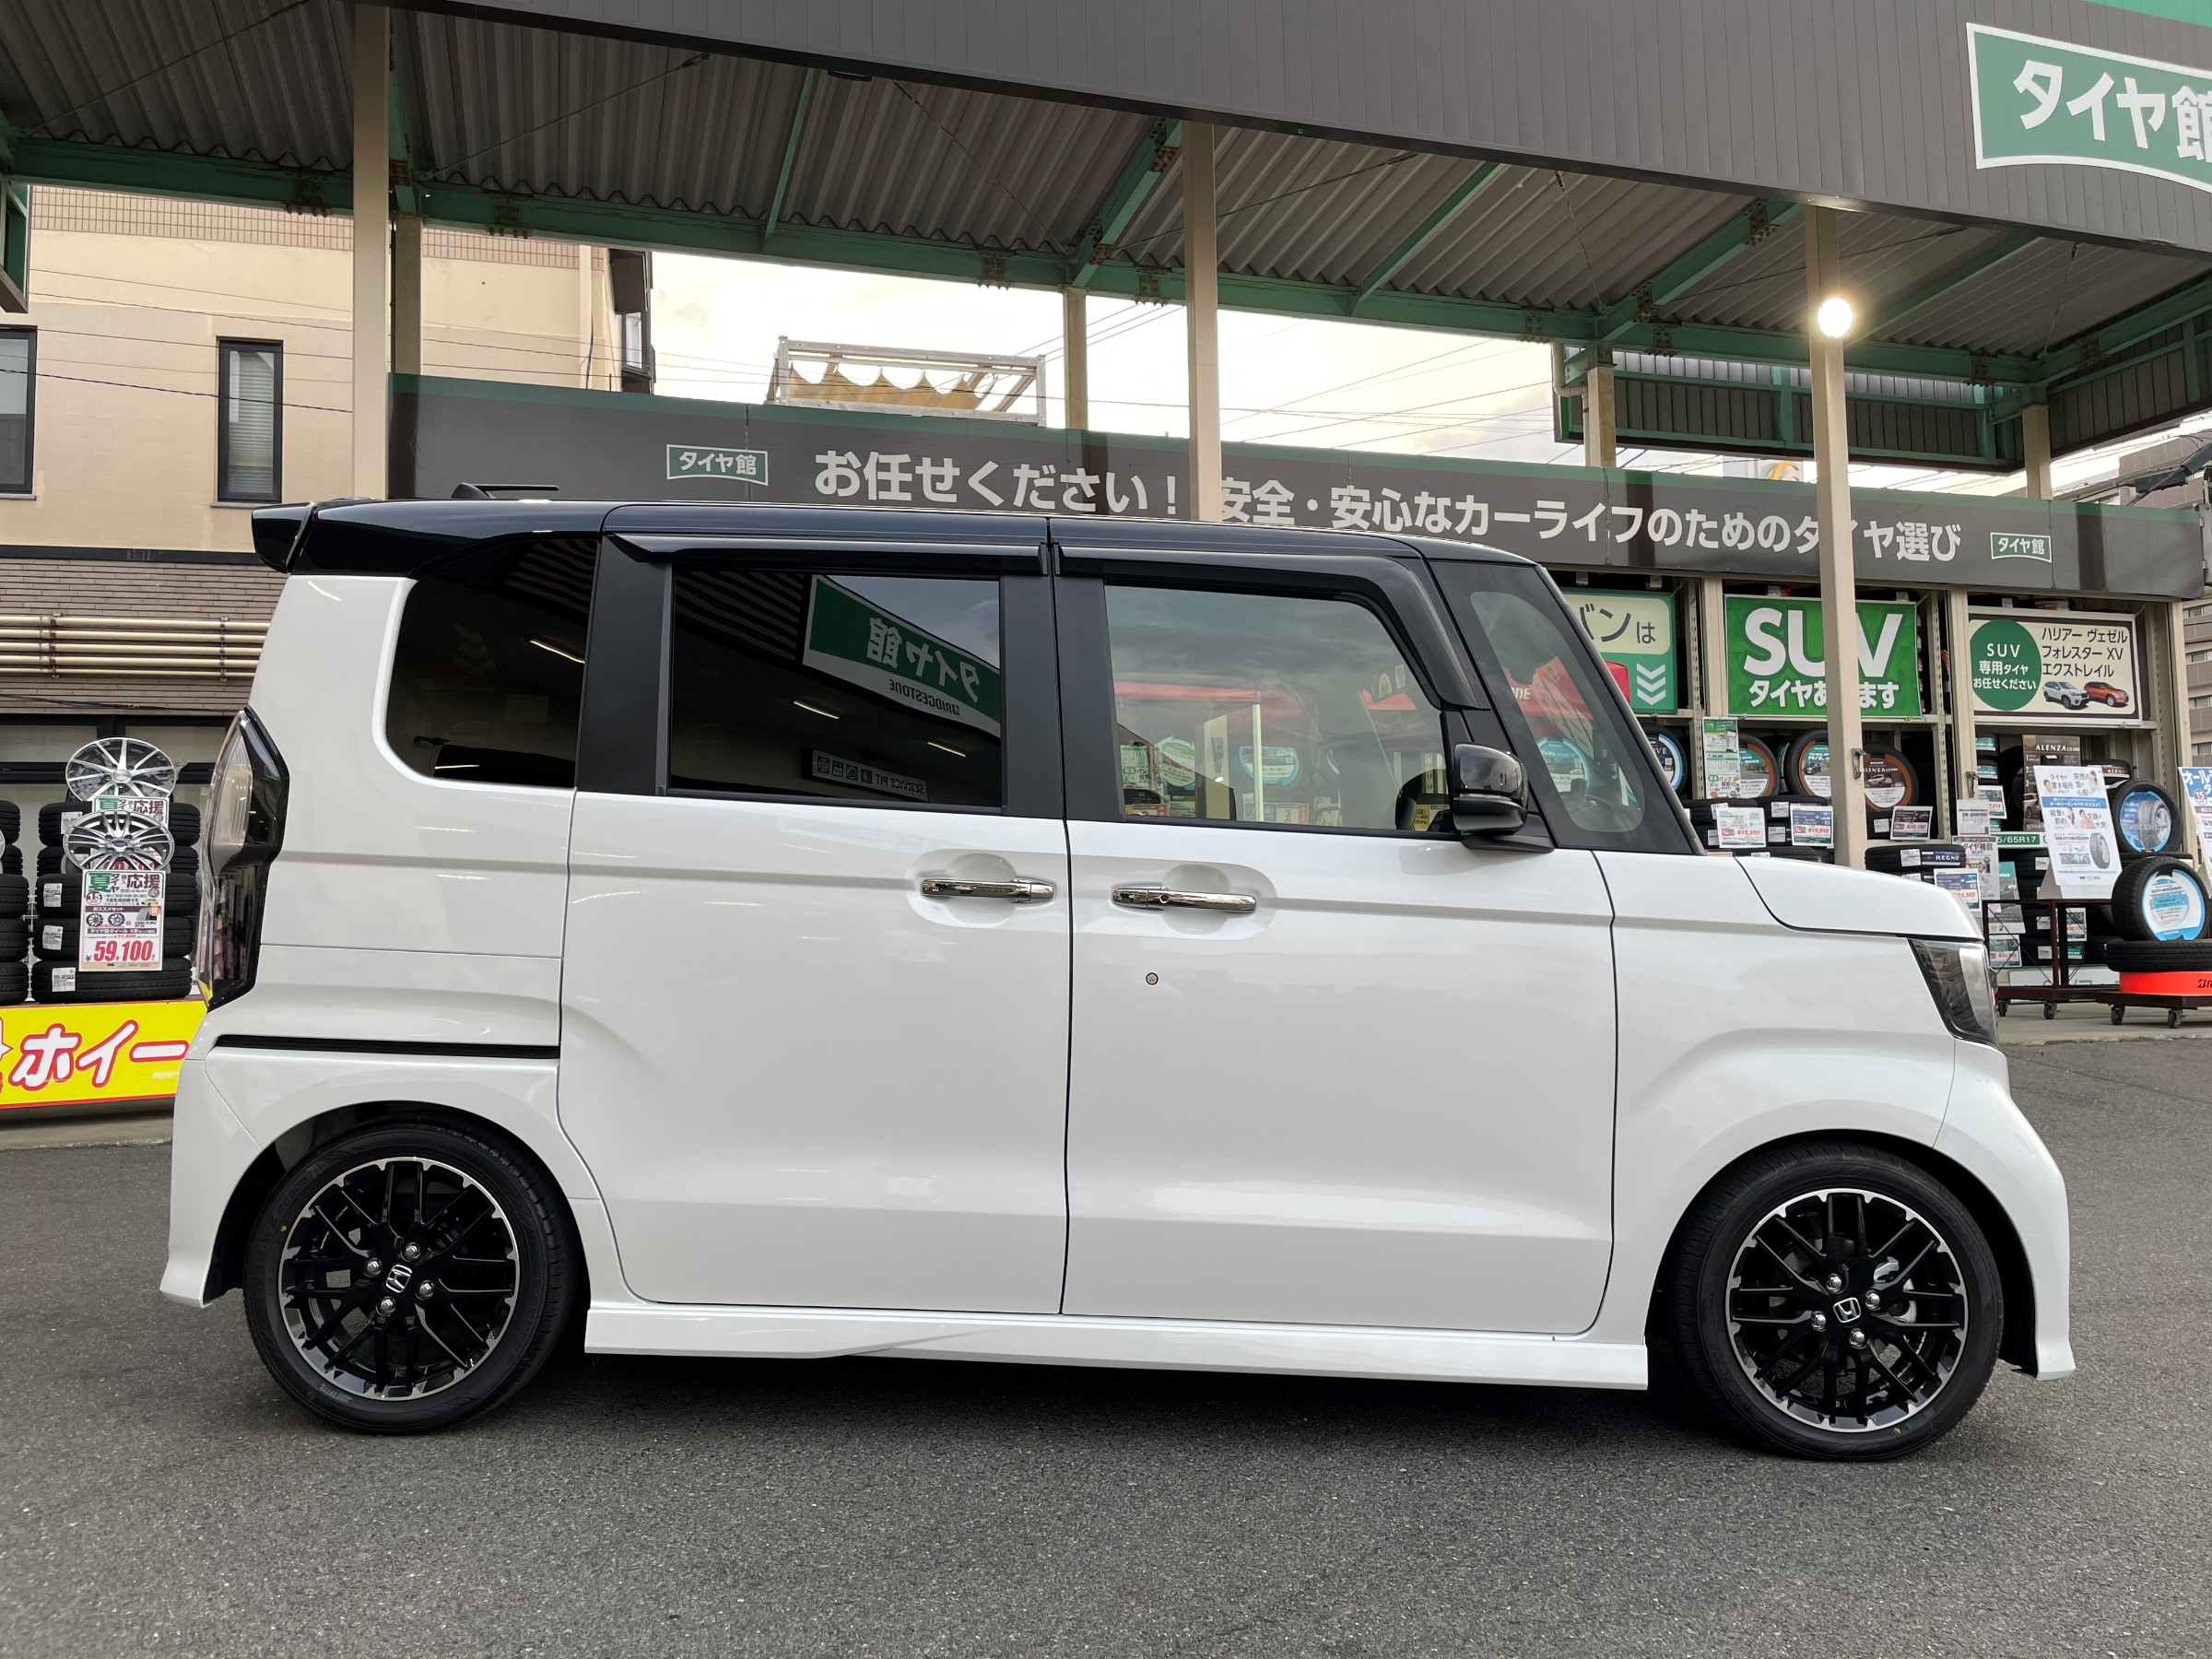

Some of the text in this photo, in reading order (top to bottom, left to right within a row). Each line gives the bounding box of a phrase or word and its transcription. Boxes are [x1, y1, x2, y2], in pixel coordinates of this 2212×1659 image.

[2013, 60, 2212, 163] タイヤ館
[678, 451, 758, 477] タイヤ館
[815, 450, 1961, 562] お任せください！ 安全・安心なカーライフのためのタヤ選び
[1998, 536, 2045, 555] タイヤ館
[1743, 606, 1903, 678] SUV
[2041, 628, 2128, 644] ハリアー ヴェゼル
[1986, 642, 2020, 658] SUV
[2042, 645, 2124, 661] フォレスター XV
[1978, 660, 2029, 676] 専用タイヤ
[2042, 663, 2114, 677] エクストレイル
[1972, 677, 2037, 690] お任せください
[1748, 679, 1900, 710] タイヤあます
[93, 940, 154, 961] 59,100
[8, 1019, 190, 1091] ホイー
